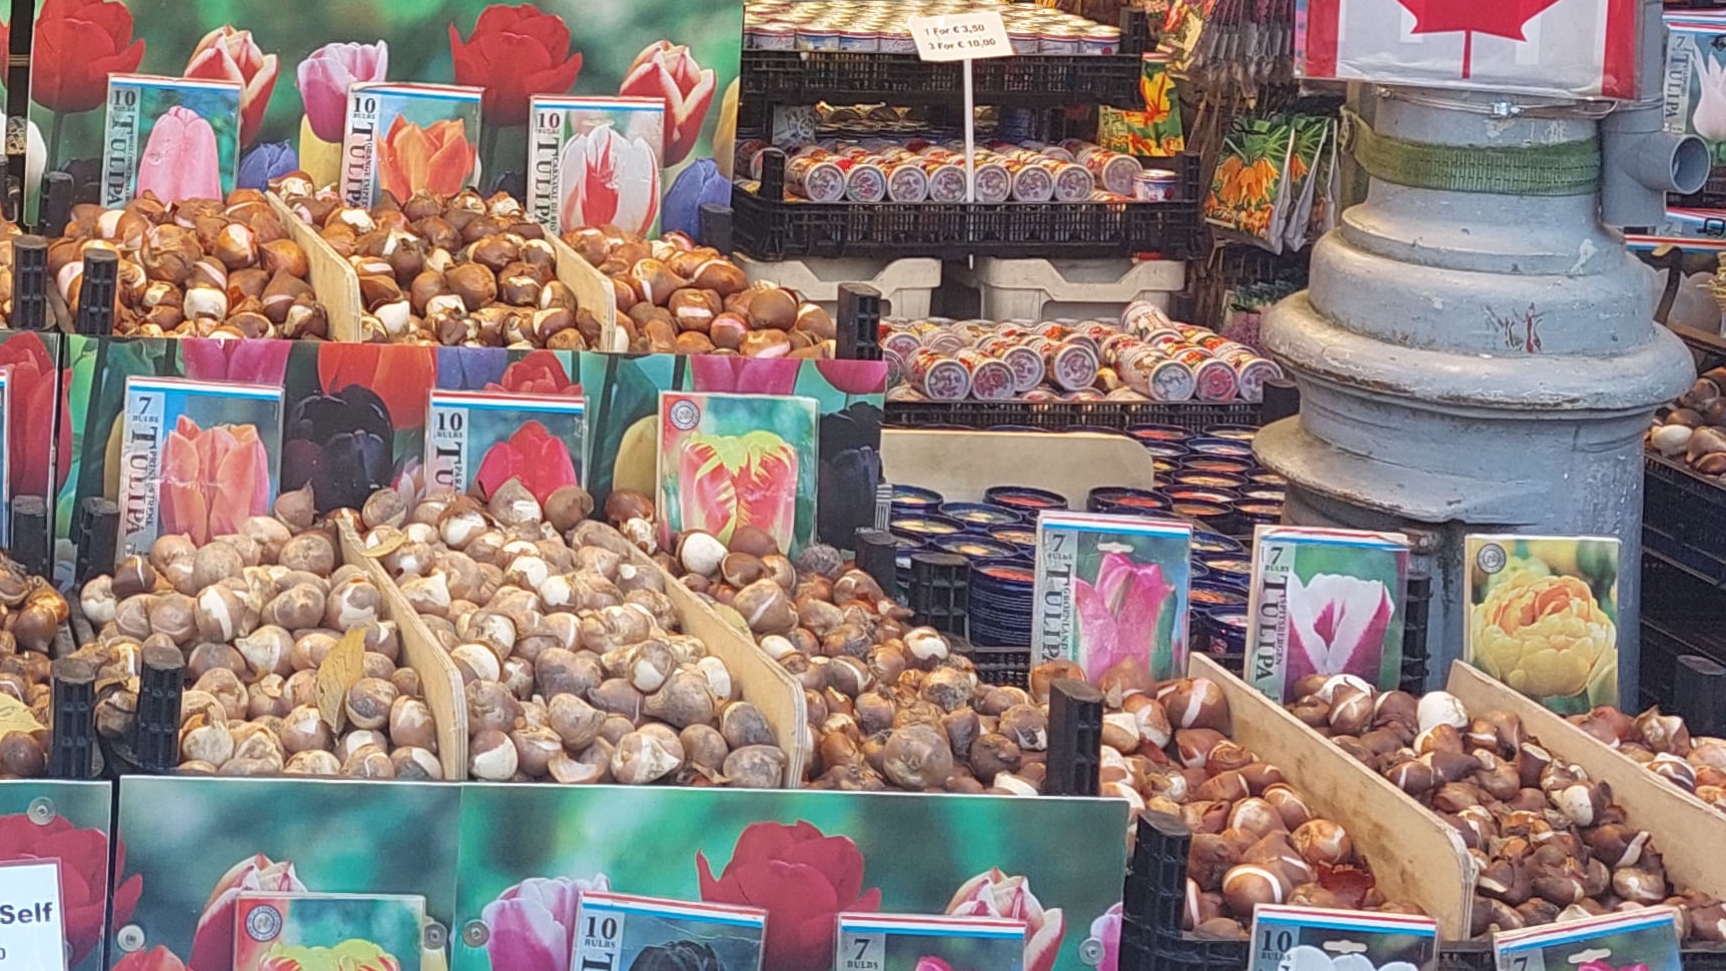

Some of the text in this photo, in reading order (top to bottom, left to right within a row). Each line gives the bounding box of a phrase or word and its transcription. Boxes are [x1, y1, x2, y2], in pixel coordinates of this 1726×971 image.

[934, 27, 950, 36] For
[952, 26, 960, 34] €
[962, 24, 985, 35] 3,50
[938, 41, 955, 50] For
[958, 40, 965, 49] €
[967, 39, 997, 49] 10,00
[1676, 36, 1686, 48] 7
[1665, 48, 1690, 119] TULIPA
[114, 91, 136, 107] 10
[354, 96, 376, 113] 10
[537, 112, 560, 129] 10
[106, 115, 135, 206] TULIPA
[535, 136, 560, 226] TULIPA
[138, 396, 152, 415] 7
[437, 412, 463, 431] 10
[125, 426, 158, 537] TULIPA
[1052, 533, 1066, 552] 7
[1271, 547, 1285, 566] 7
[1061, 586, 1073, 650] GROENLAND
[1256, 575, 1288, 682] TULIPA
[586, 916, 617, 940] 10
[853, 938, 871, 960] 7
[1260, 930, 1293, 953] 10
